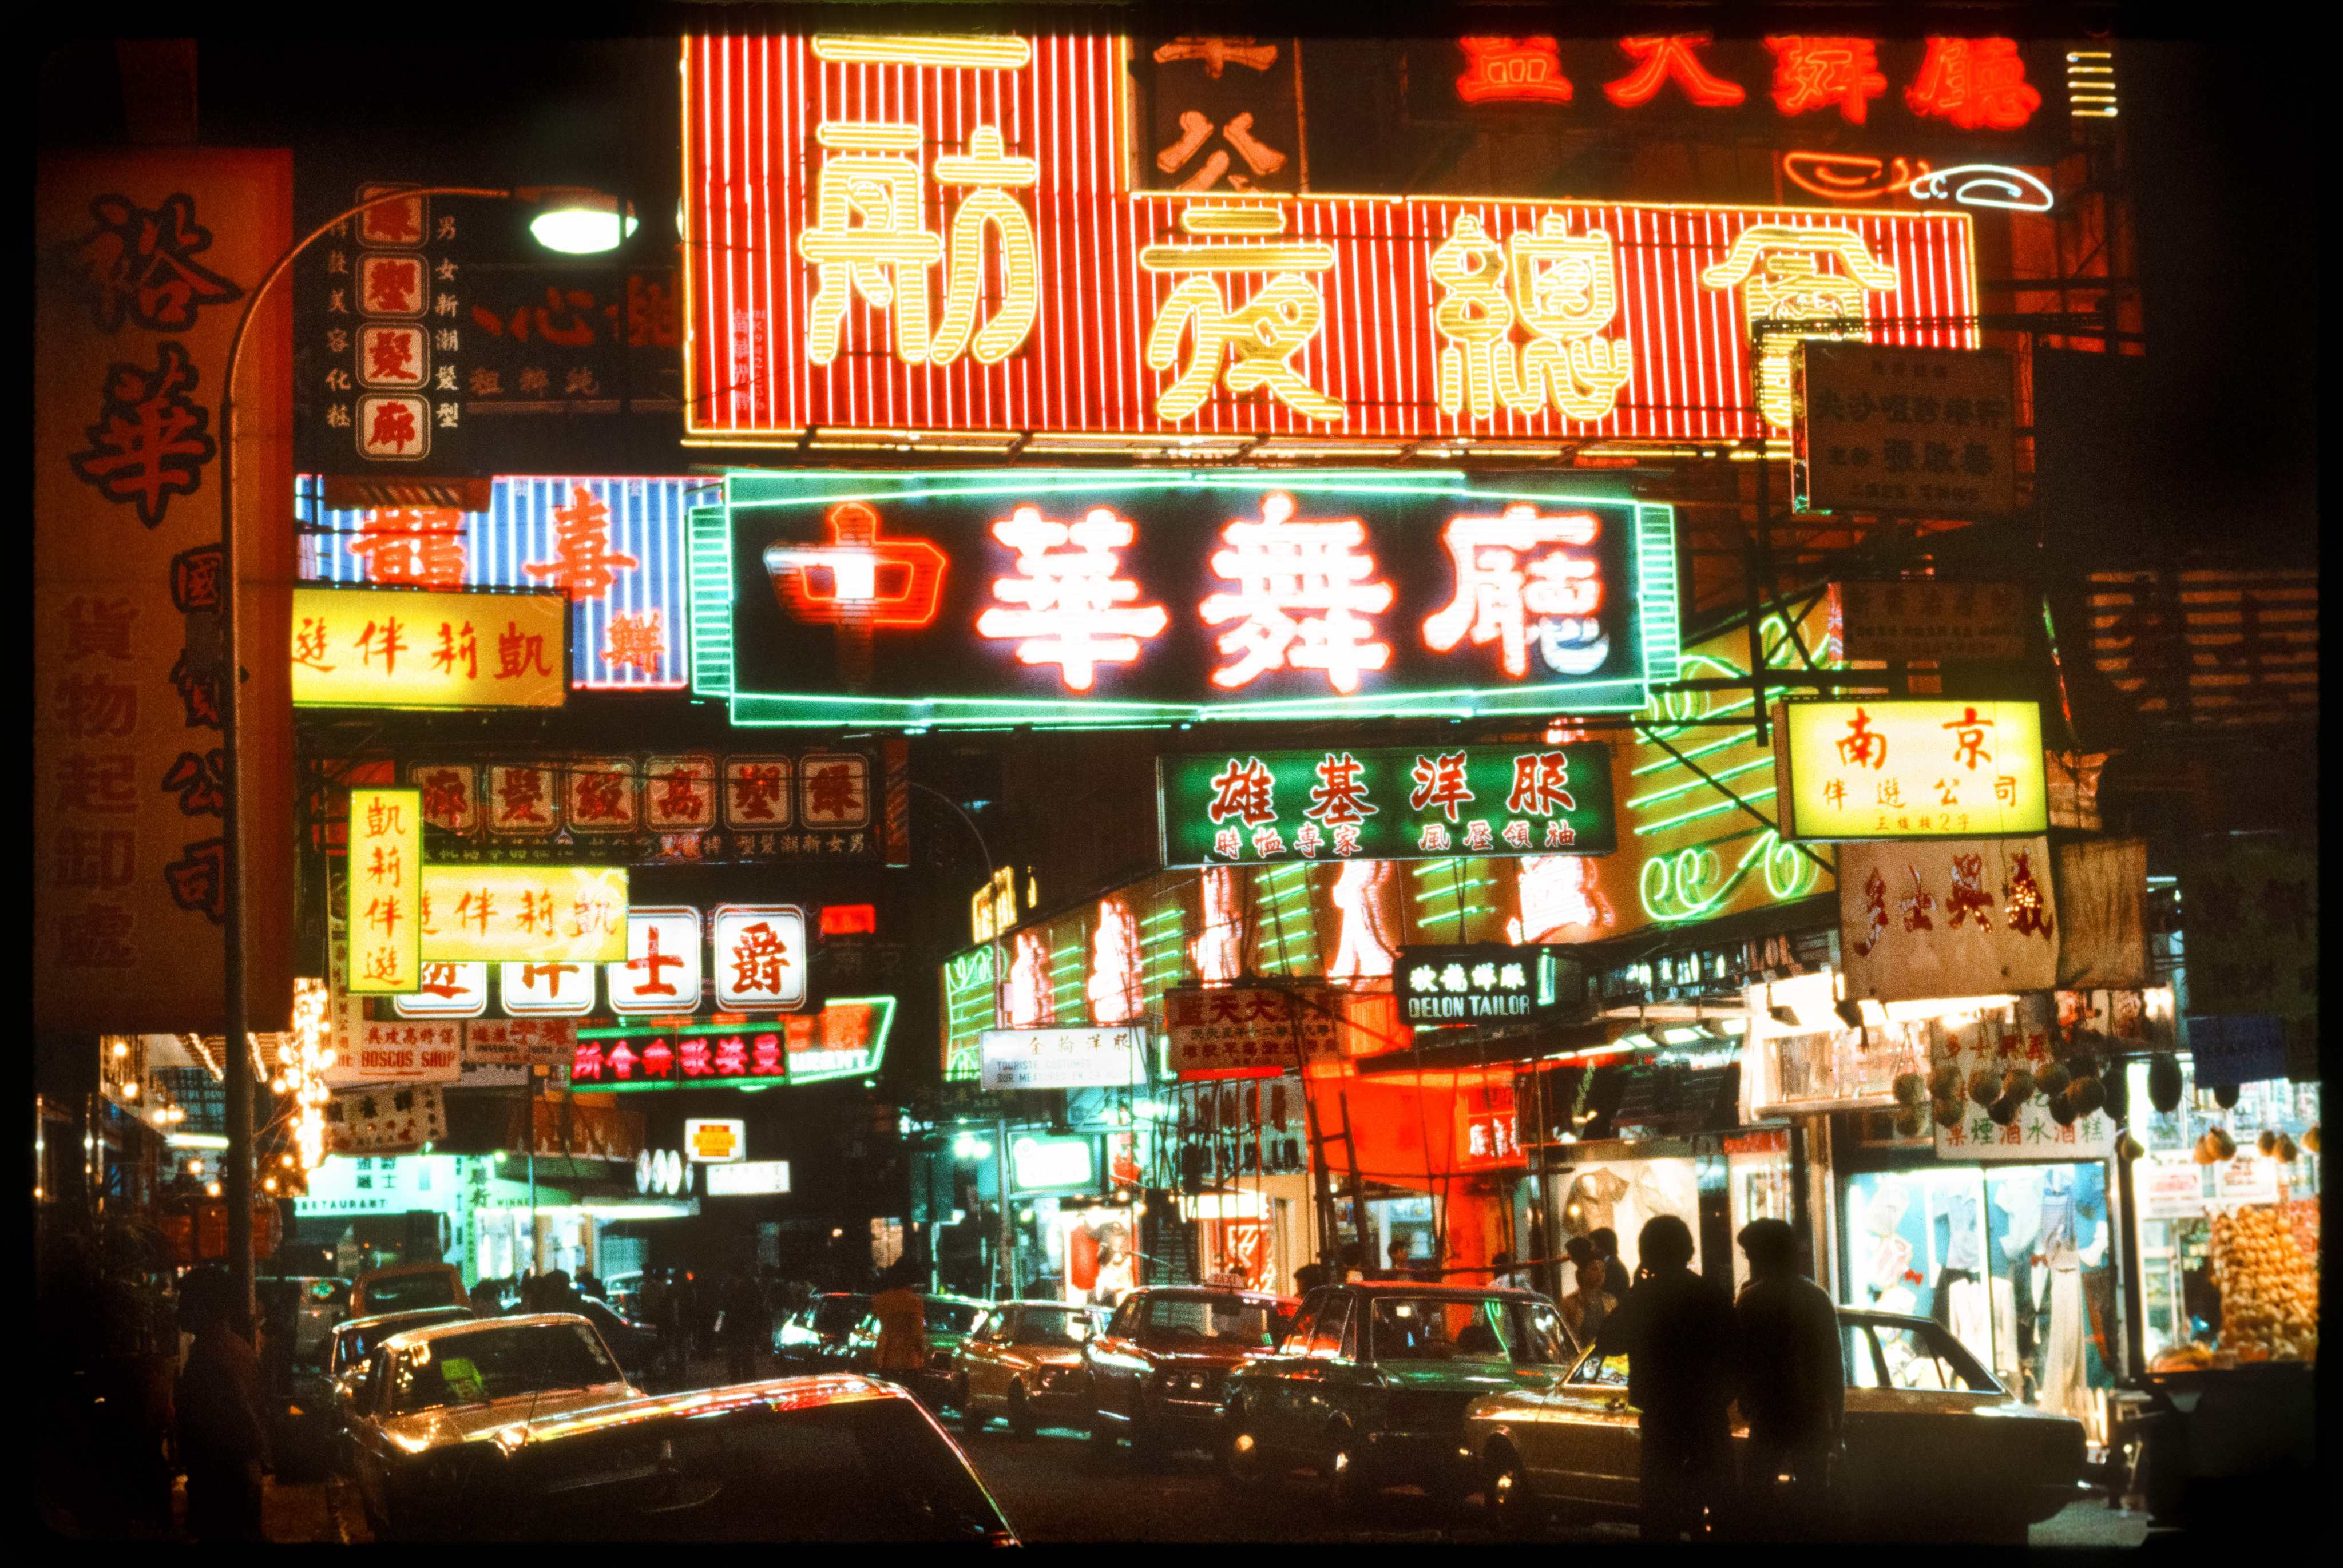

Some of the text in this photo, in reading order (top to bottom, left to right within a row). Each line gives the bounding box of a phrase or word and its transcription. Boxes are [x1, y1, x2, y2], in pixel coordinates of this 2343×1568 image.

[764, 491, 1611, 693] 中華舞廳
[1835, 706, 1995, 771] 南京
[1208, 749, 1577, 827] 雄基洋服
[1823, 776, 2018, 810] 伴遊公司
[363, 796, 406, 986] 凱莉伴遊
[1409, 994, 1531, 1018] DELON TAILOR
[421, 1050, 455, 1068] SHOP
[997, 1073, 1014, 1083] SUR
[295, 1198, 387, 1210] ESTAURANT
